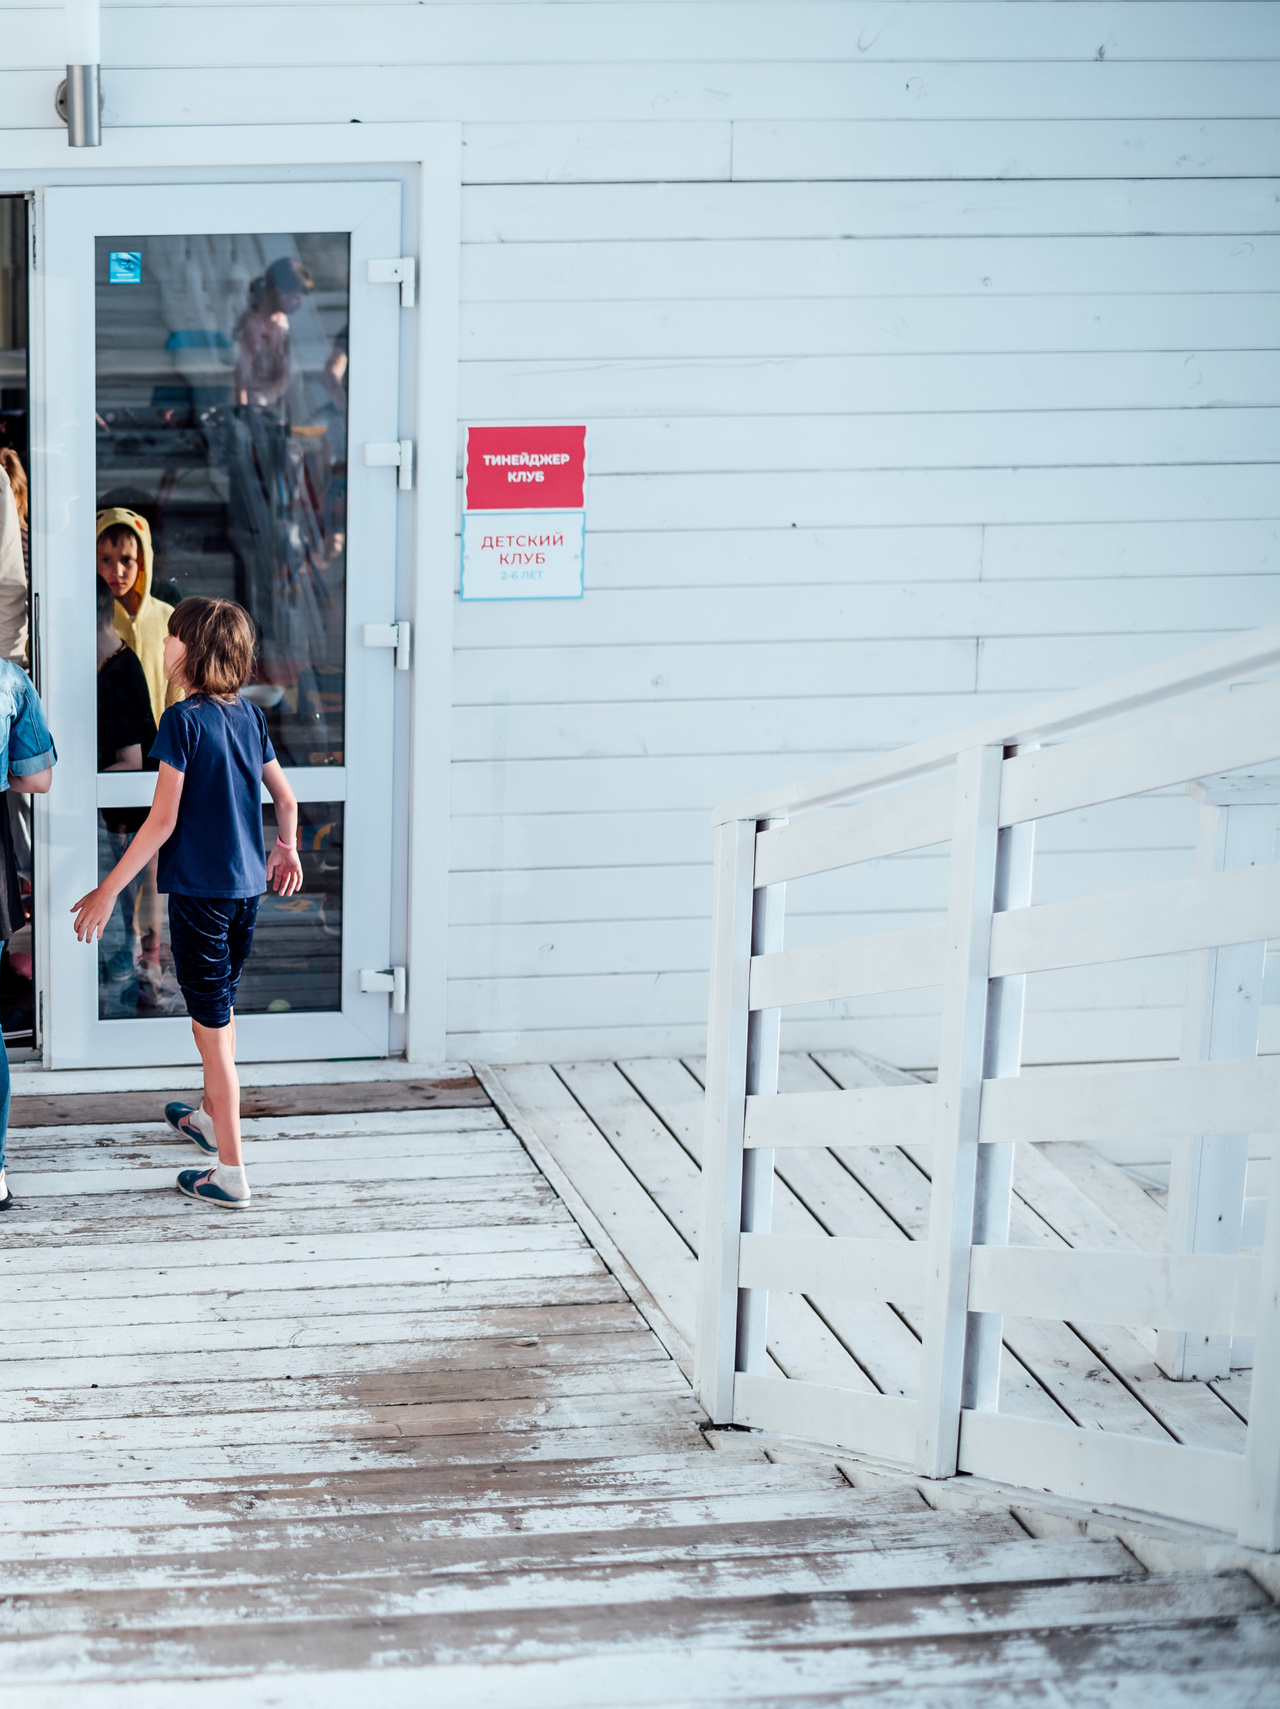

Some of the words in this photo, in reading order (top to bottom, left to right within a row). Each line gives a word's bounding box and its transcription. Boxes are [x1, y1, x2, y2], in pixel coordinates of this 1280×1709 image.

[483, 452, 570, 467] ТИНЕЙДЖЕР
[507, 471, 545, 483] КЛУБ
[481, 531, 564, 550] ДЕТСКИЙ
[499, 552, 546, 565] КЛУБ
[501, 571, 518, 580] 2-6
[521, 570, 544, 580] ЛЕТ
